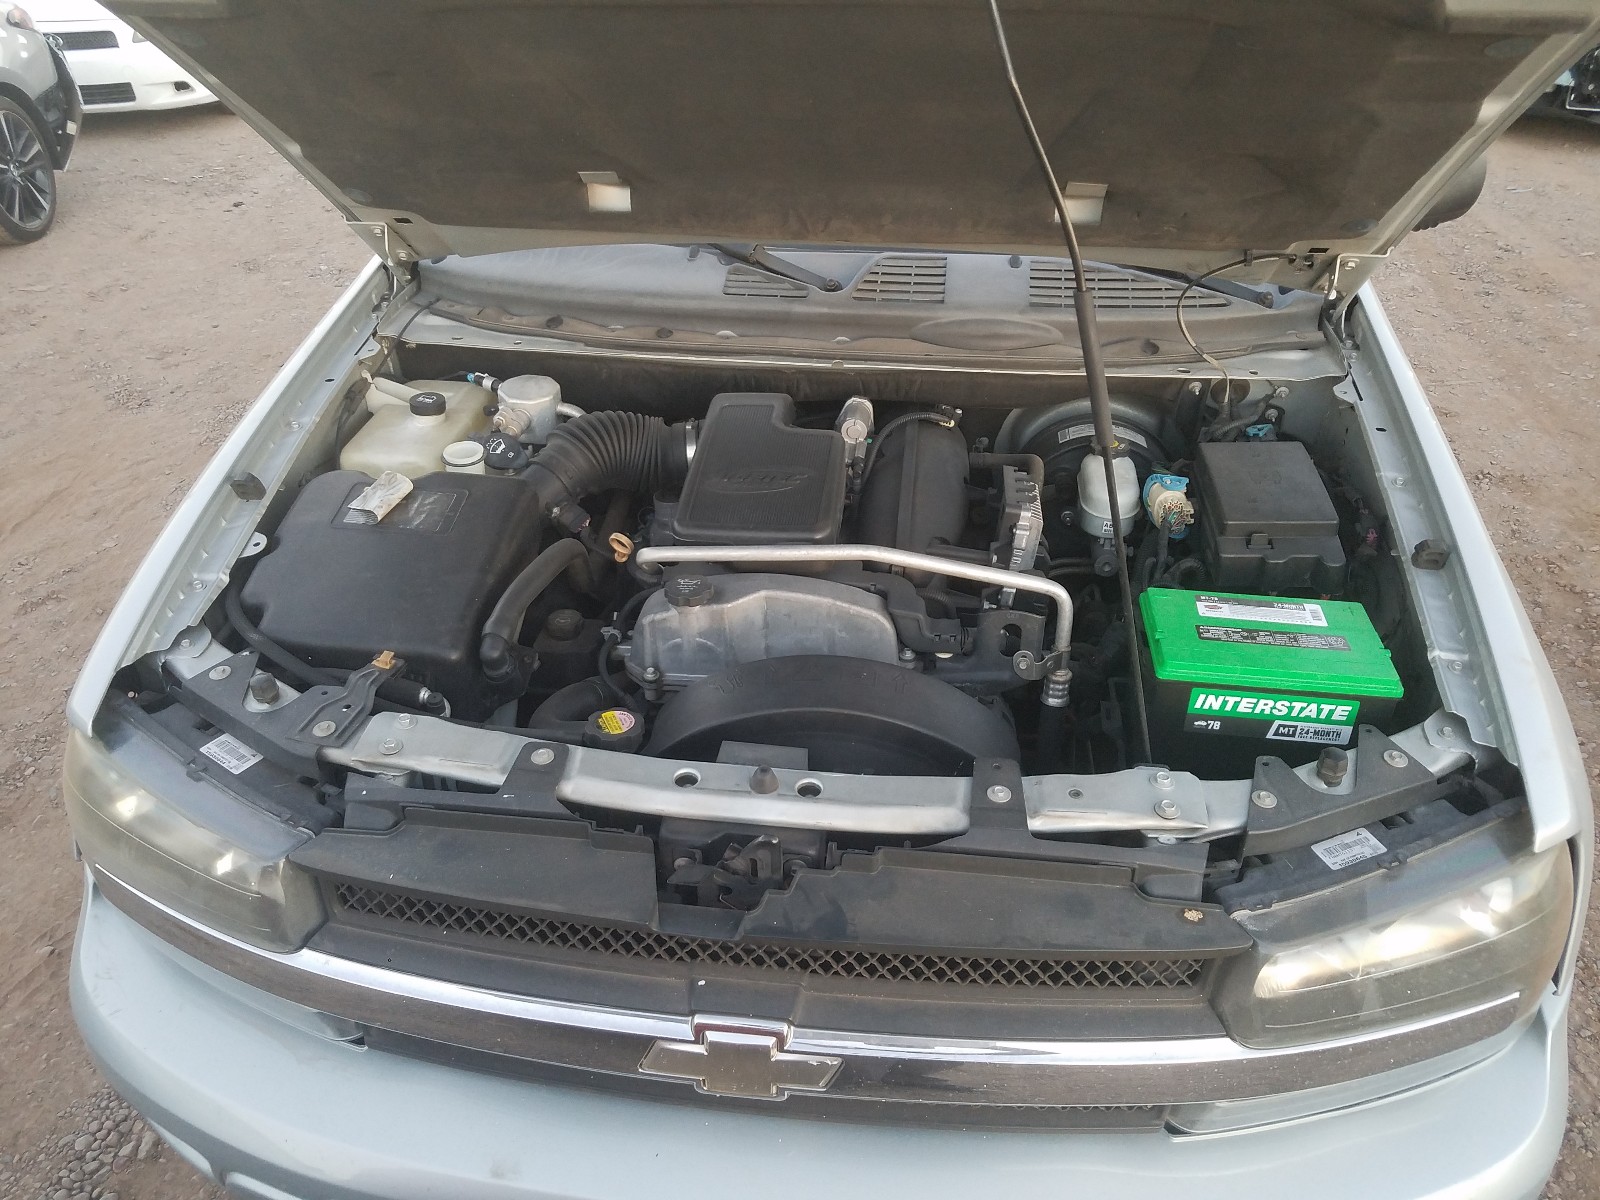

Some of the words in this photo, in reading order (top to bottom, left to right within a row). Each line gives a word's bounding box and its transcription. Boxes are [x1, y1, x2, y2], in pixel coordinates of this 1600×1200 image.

[1194, 694, 1352, 720] INTERSTATE
[1207, 720, 1221, 730] 78
[1278, 727, 1295, 735] MT
[1299, 728, 1342, 739] 24-MONTH
